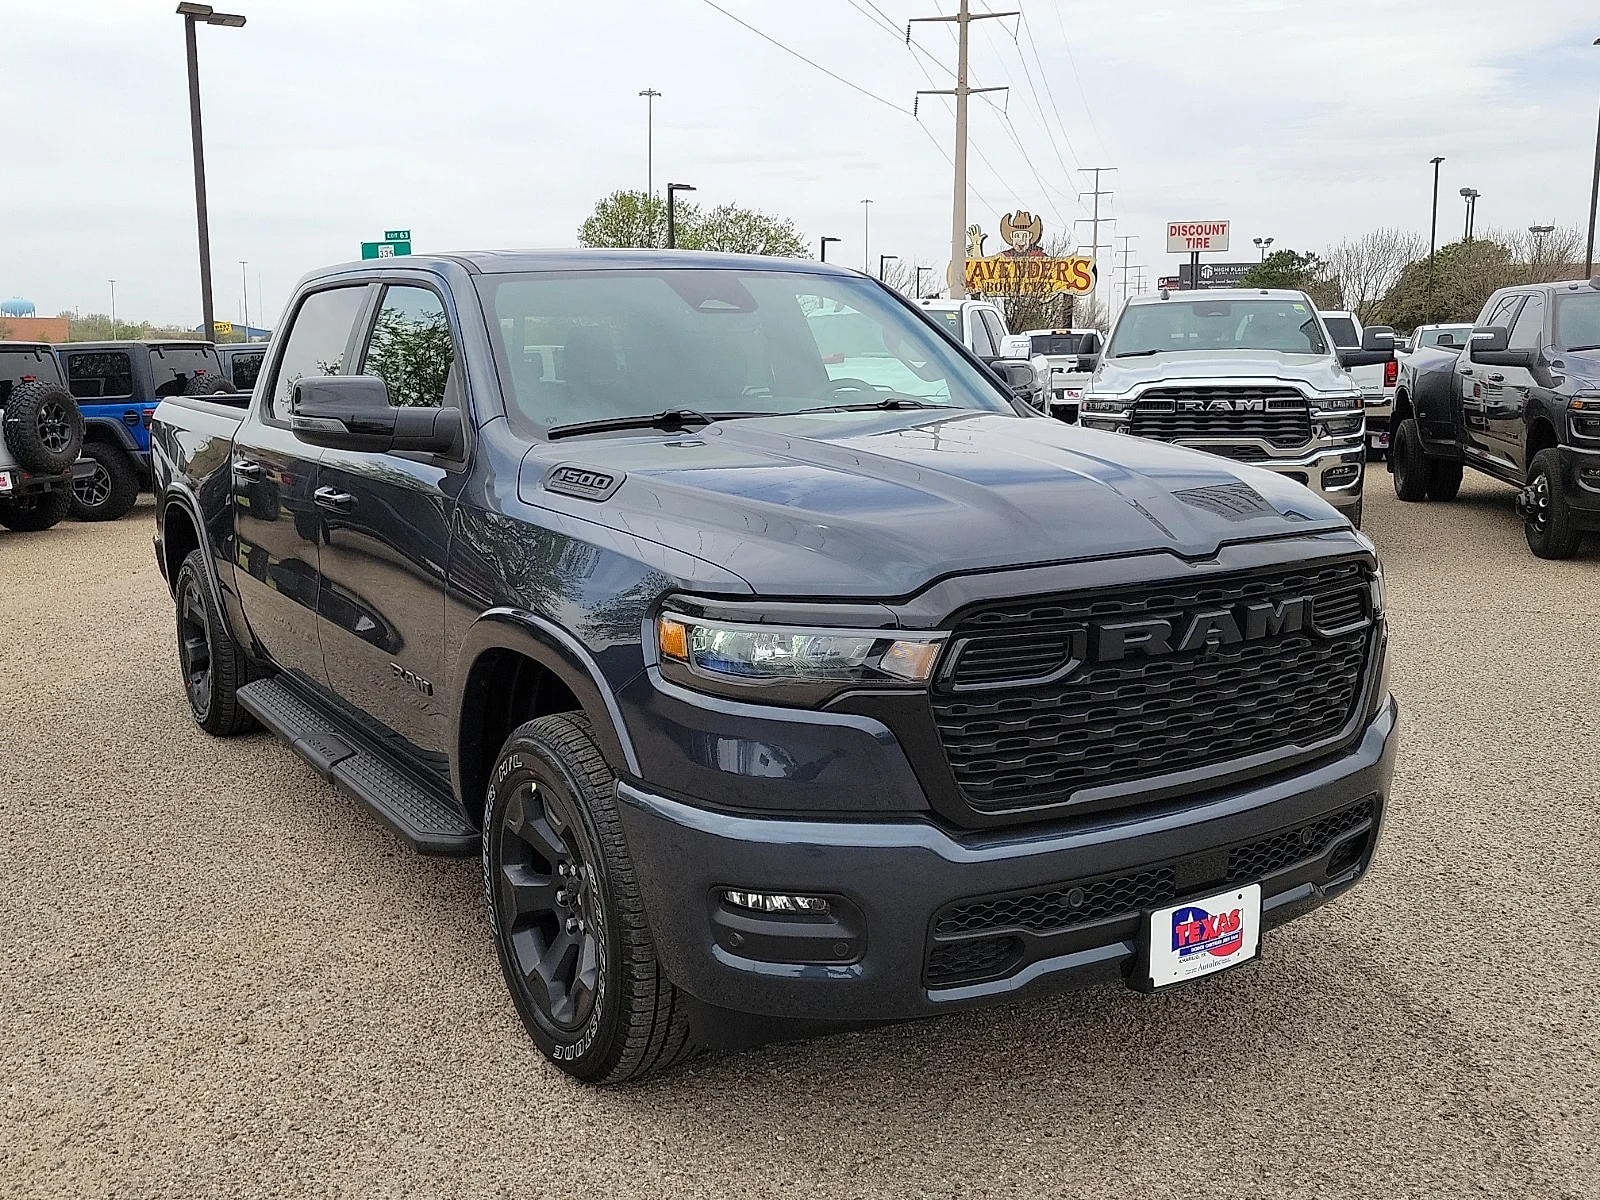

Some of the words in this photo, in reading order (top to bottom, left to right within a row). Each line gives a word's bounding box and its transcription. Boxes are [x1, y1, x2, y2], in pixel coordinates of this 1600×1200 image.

[1170, 224, 1227, 237] DISCOUNT
[1185, 237, 1210, 249] TIRE
[965, 257, 1091, 291] AVENDER'S
[1177, 399, 1264, 412] RAM
[554, 469, 613, 489] 1500
[1099, 596, 1304, 662] RAM
[390, 661, 434, 698] RAM
[1175, 908, 1241, 947] TEXAS
